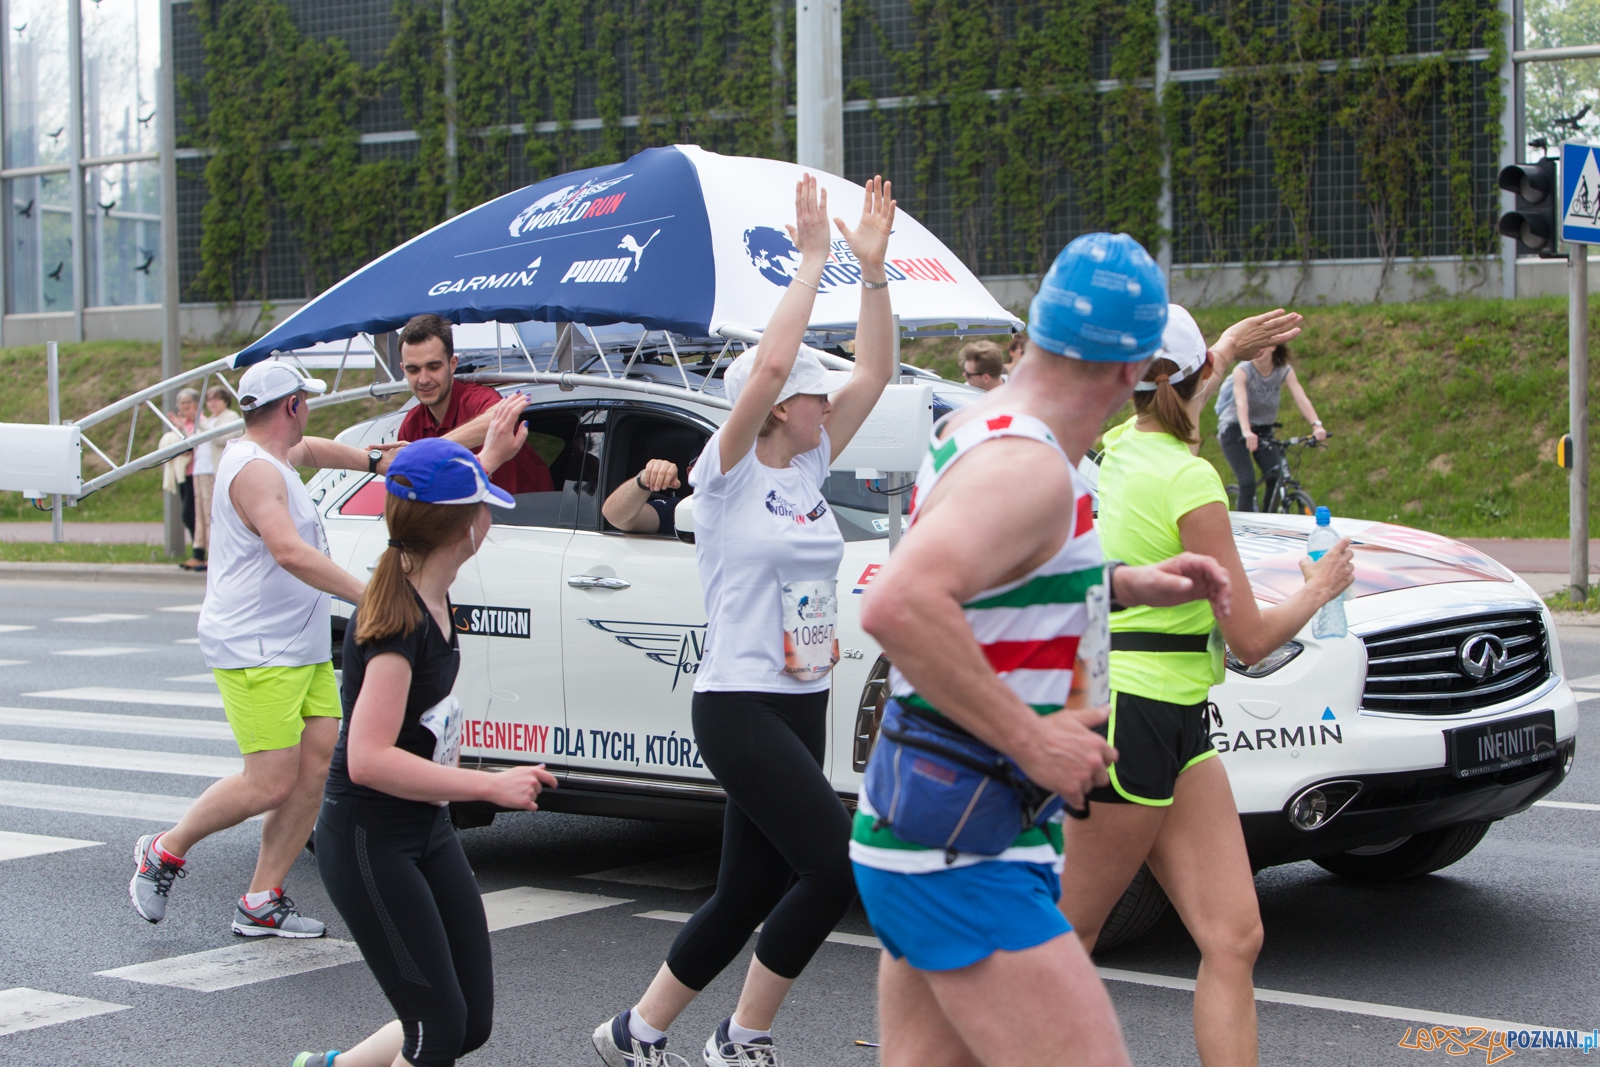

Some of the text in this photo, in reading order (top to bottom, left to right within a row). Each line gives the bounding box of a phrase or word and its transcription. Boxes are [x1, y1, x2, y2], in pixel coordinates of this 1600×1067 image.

[428, 269, 538, 296] GARMIN
[560, 257, 632, 283] PUMA
[471, 608, 529, 636] SATURN
[554, 726, 585, 757] DLA
[589, 730, 640, 767] TYCH,
[645, 730, 704, 769] KTÓRZ
[1209, 724, 1343, 754] GARMIN
[1478, 725, 1536, 762] INFINITI
